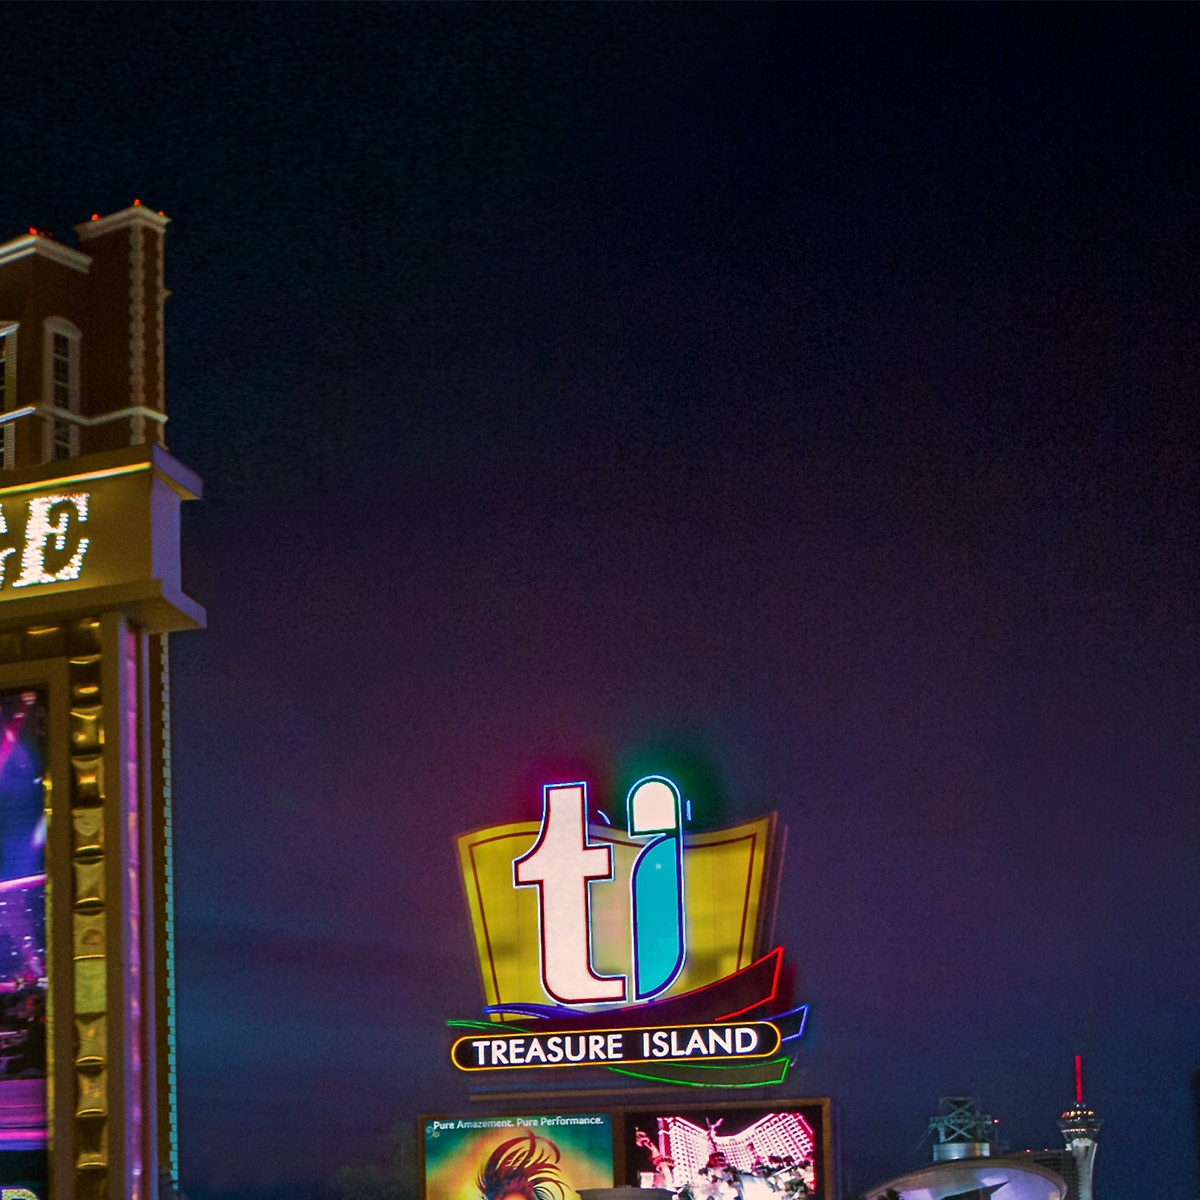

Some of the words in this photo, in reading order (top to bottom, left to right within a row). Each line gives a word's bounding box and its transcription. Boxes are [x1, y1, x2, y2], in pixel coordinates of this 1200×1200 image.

[511, 774, 687, 1007] ti
[471, 1033, 624, 1067] TREASURE
[642, 1027, 759, 1058] ISLAND
[433, 1121, 455, 1130] Pure
[456, 1119, 515, 1130] Amazement.
[516, 1117, 539, 1127] Pure
[540, 1115, 604, 1127] Performance.
